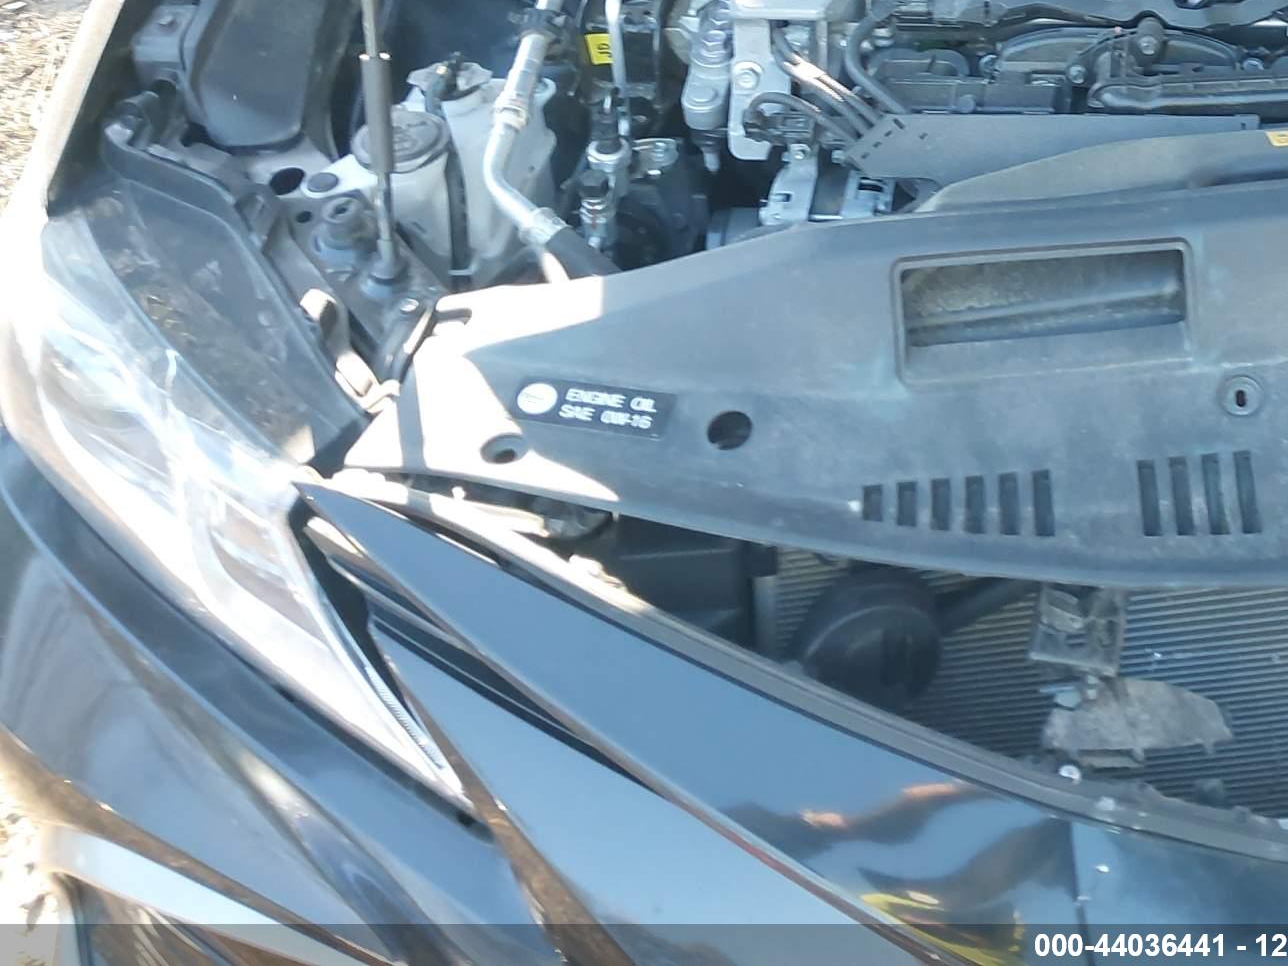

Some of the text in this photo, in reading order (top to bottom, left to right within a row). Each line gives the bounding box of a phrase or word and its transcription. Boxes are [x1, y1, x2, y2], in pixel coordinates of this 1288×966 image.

[565, 388, 627, 408] ENGINE
[630, 396, 657, 413] OIL
[558, 403, 596, 421] SAE
